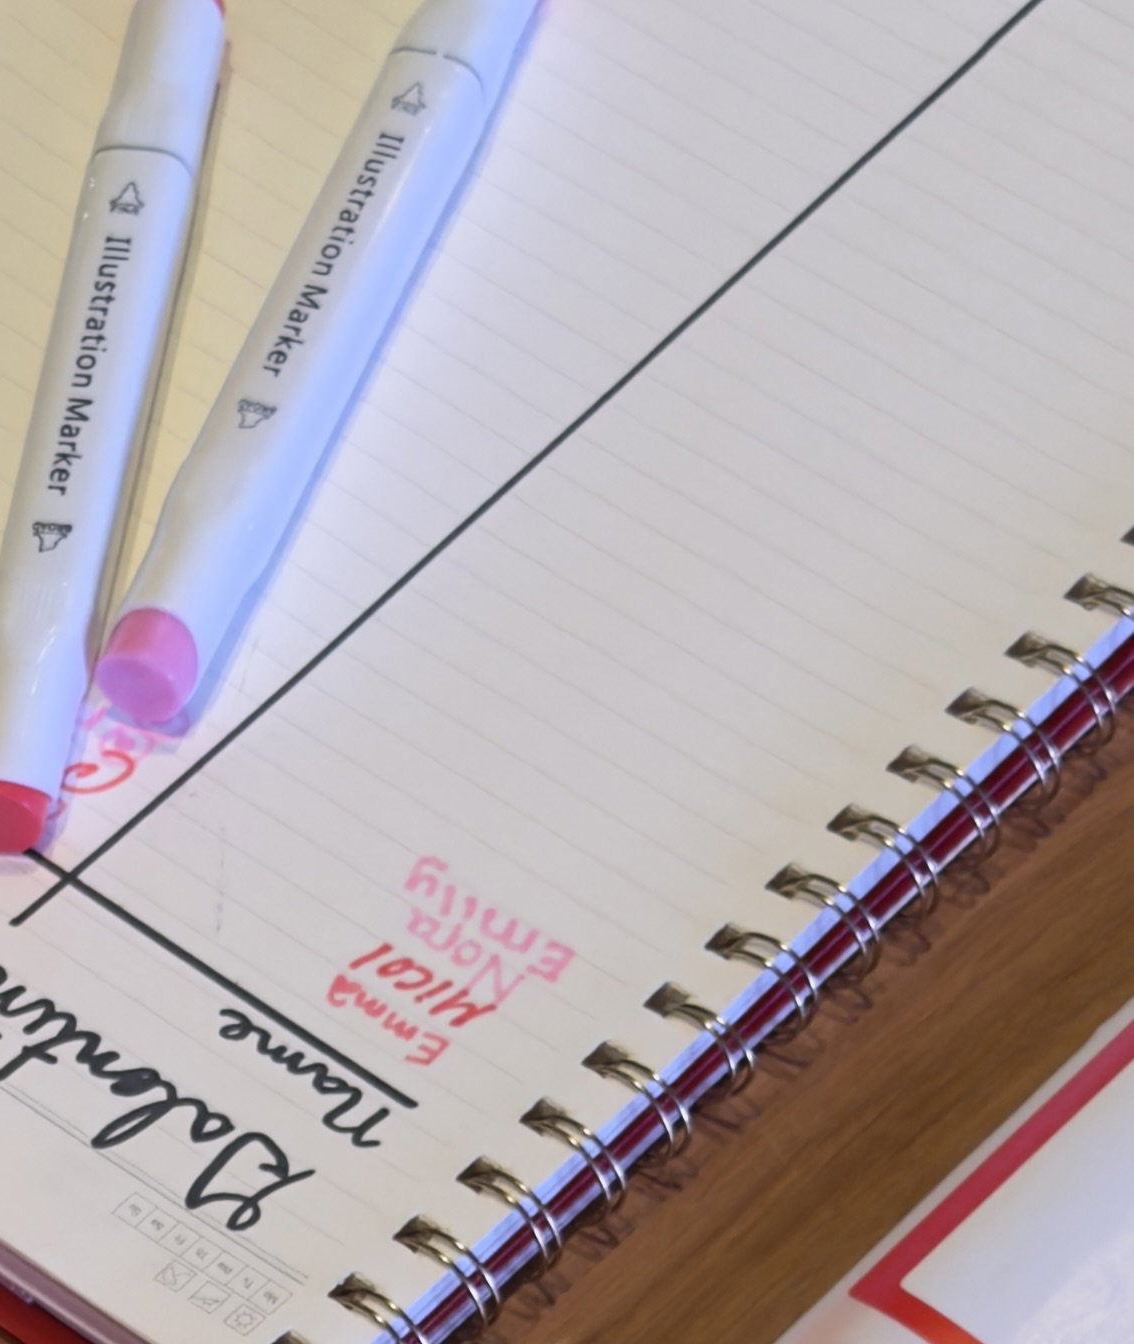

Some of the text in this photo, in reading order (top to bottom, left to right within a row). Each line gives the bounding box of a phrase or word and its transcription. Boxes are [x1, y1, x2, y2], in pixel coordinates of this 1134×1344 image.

[70, 236, 132, 388] Illustration
[262, 130, 406, 378] Illustration Marker
[47, 397, 94, 496] Marker
[403, 855, 577, 983] Emily
[406, 905, 526, 1005] Nora
[219, 1008, 390, 1148] Name
